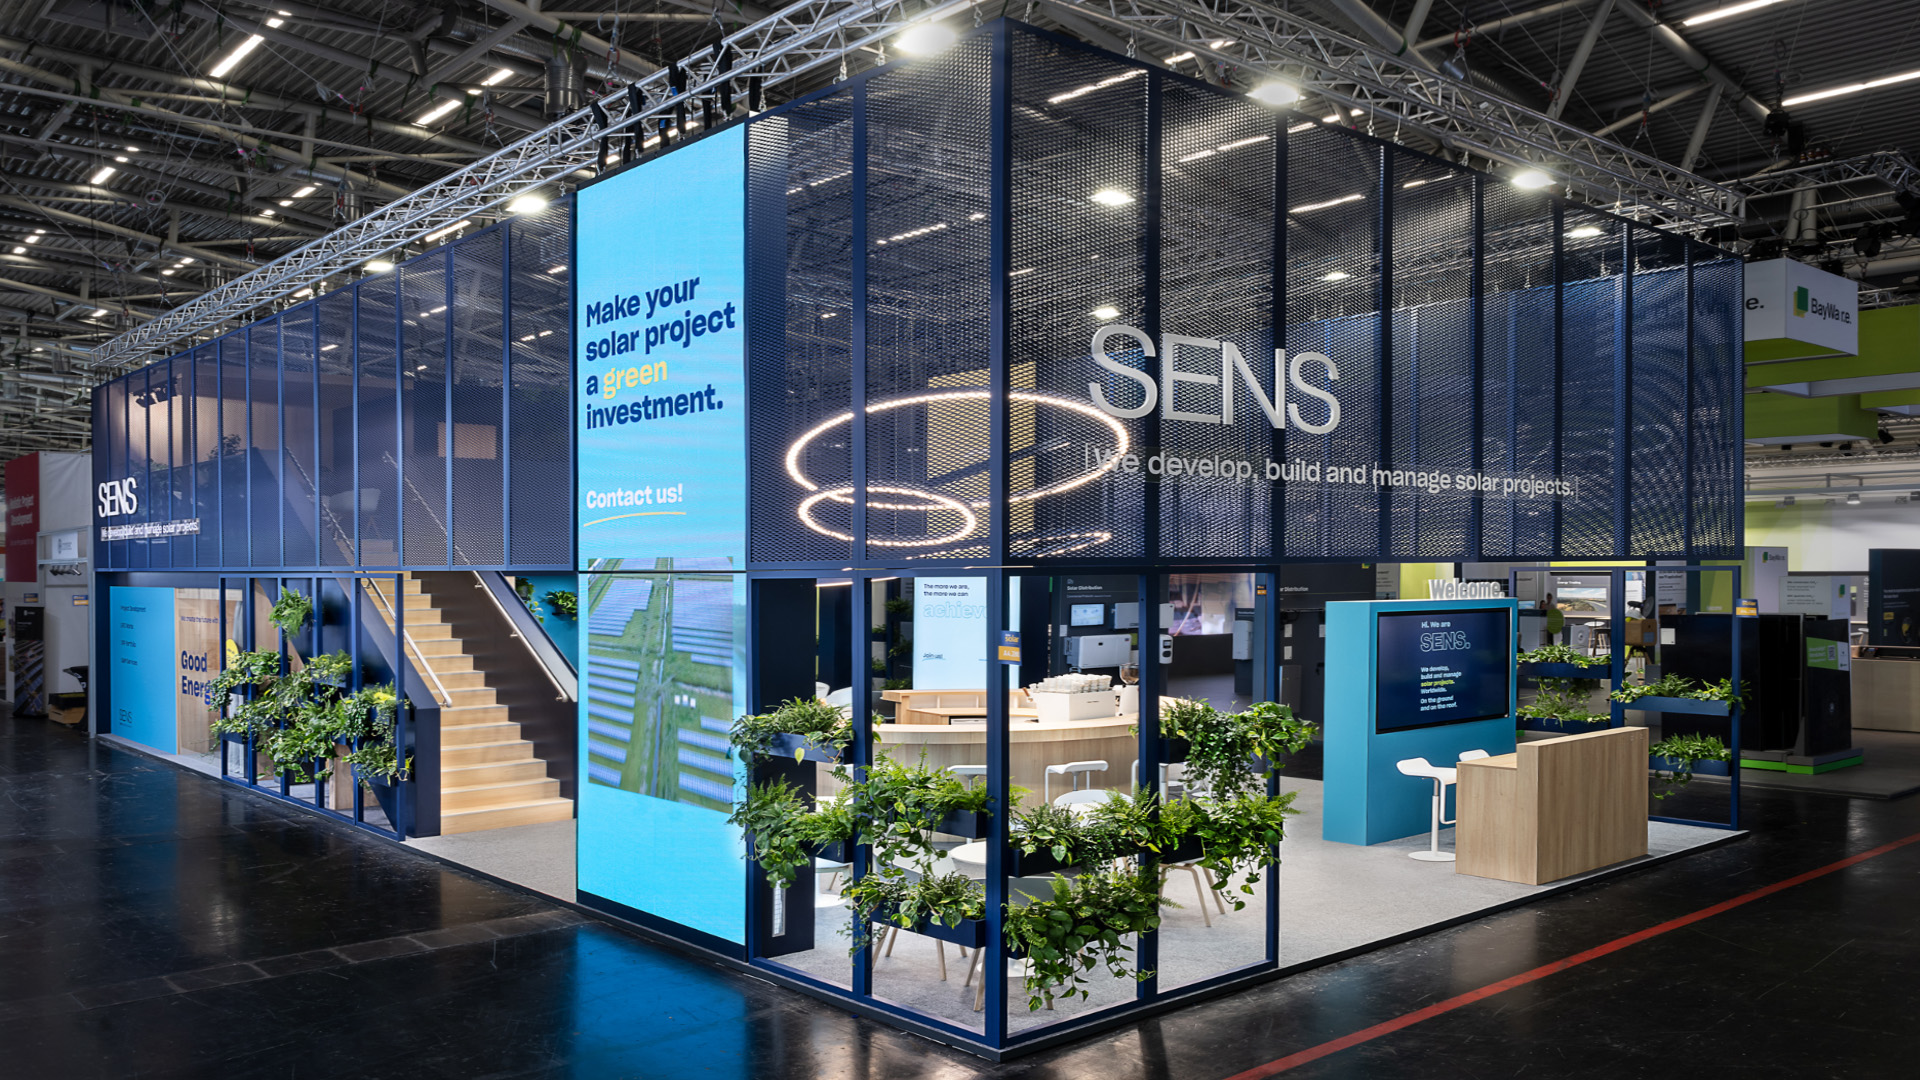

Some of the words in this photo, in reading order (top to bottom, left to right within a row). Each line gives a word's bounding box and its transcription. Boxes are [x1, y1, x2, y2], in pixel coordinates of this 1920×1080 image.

[586, 294, 640, 327] Make
[645, 276, 700, 319] your
[1811, 298, 1840, 320] BayWa
[586, 330, 639, 361] solar
[645, 302, 735, 354] project
[586, 374, 598, 395] a
[603, 360, 668, 400] green
[1088, 324, 1341, 434] SENS
[586, 384, 723, 430] investment.
[1095, 447, 1140, 473] We
[1148, 451, 1259, 482] develop,
[1265, 458, 1320, 482] build
[1326, 464, 1367, 484] and
[1374, 469, 1451, 494] manage
[1456, 472, 1499, 491] solar
[1503, 474, 1574, 498] projects.
[98, 476, 138, 517] SENS
[586, 485, 652, 509] Contact
[656, 483, 683, 504] us!
[1428, 577, 1505, 599] Welcome.
[923, 600, 987, 619] achiev
[1420, 630, 1471, 652] SENS.
[181, 650, 208, 672] Good
[1436, 695, 1454, 703] ground
